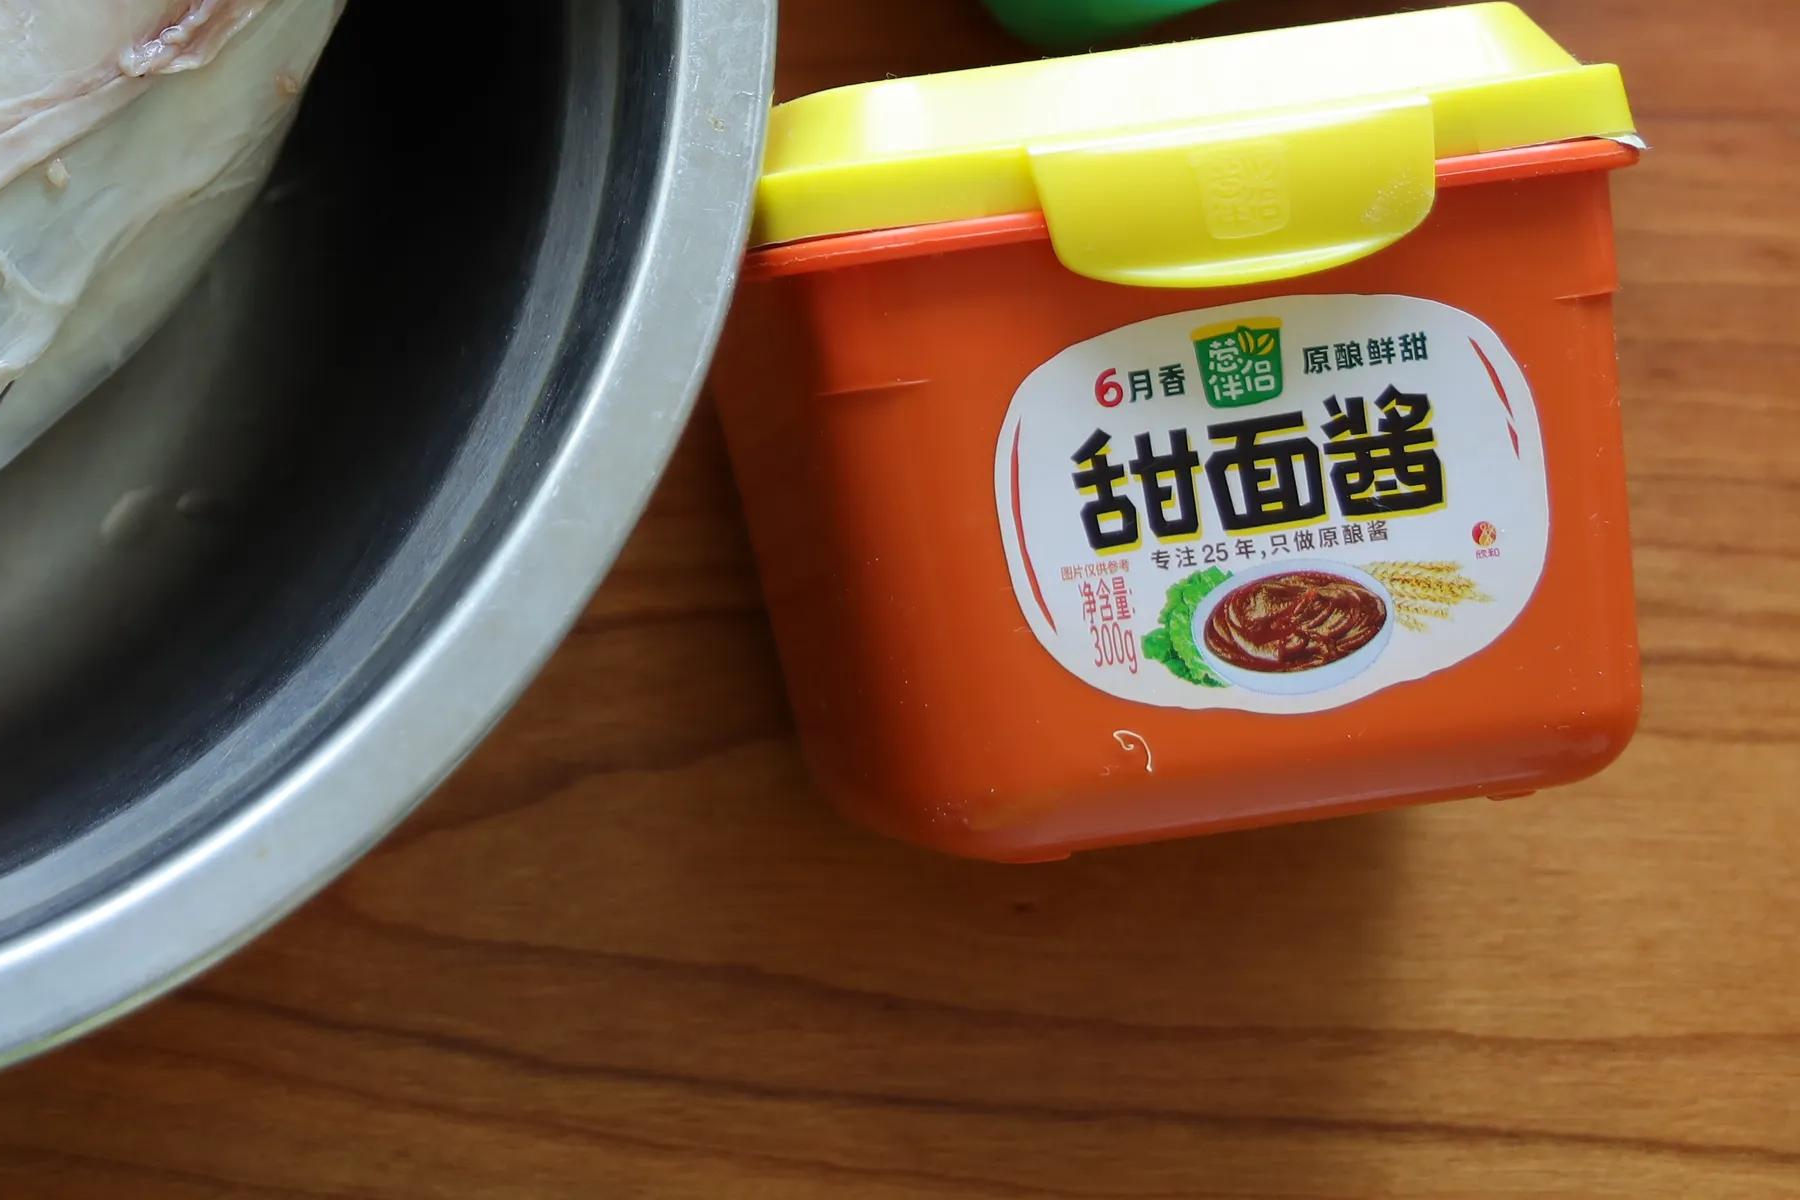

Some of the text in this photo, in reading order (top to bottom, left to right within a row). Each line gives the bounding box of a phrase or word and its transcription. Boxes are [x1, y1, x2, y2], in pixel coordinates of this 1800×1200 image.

[1303, 331, 1429, 375] 原酿鲜甜
[1094, 362, 1186, 408] 6月香
[1070, 383, 1447, 555] 甜面酱
[1089, 622, 1138, 674] 300g
